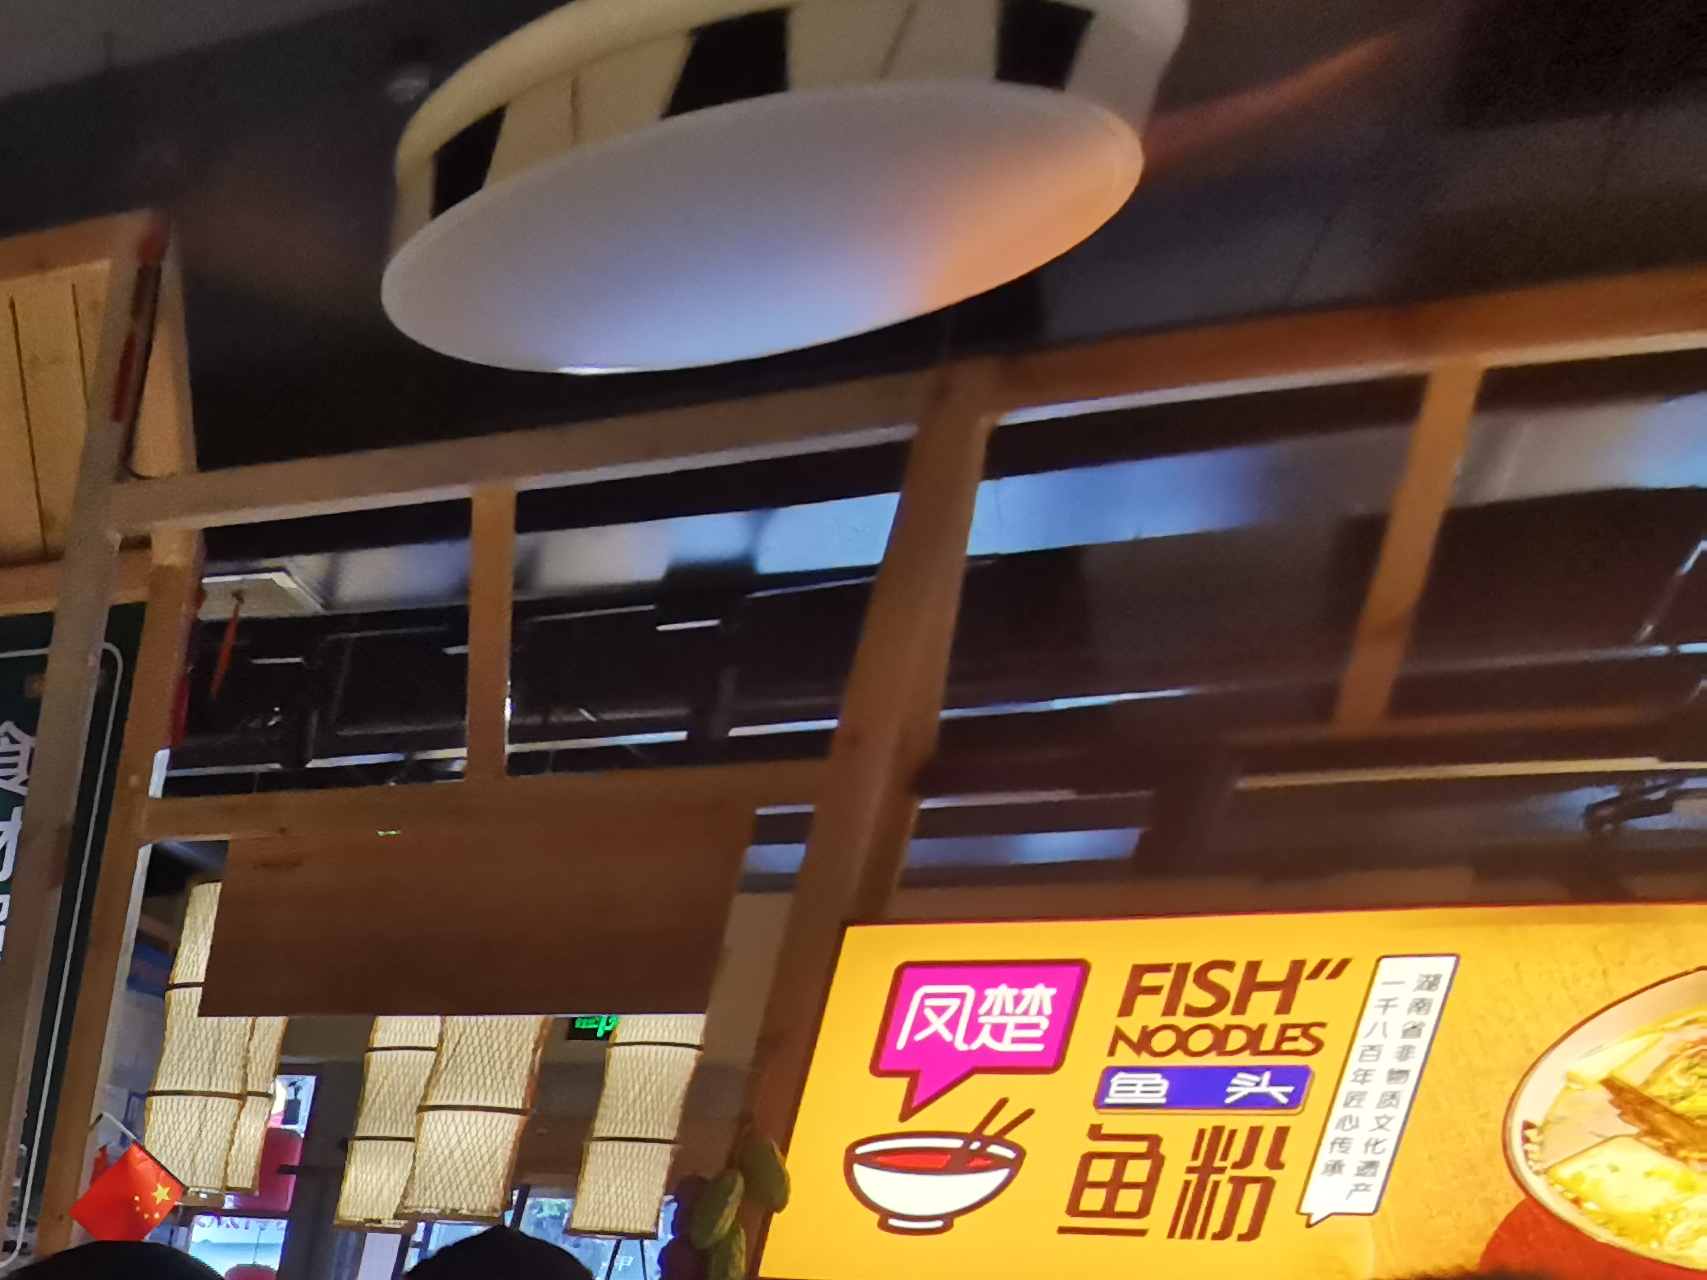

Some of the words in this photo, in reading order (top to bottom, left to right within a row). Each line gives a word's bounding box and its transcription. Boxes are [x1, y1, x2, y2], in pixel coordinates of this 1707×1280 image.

[895, 982, 1058, 1053] 凤楚
[1106, 1021, 1328, 1058] NOODLES
[1319, 979, 1407, 1178] 一千八百年匠心传承
[1344, 973, 1443, 1201] 湖南省非物质文化遗产
[1056, 1123, 1292, 1243] 鱼粉
